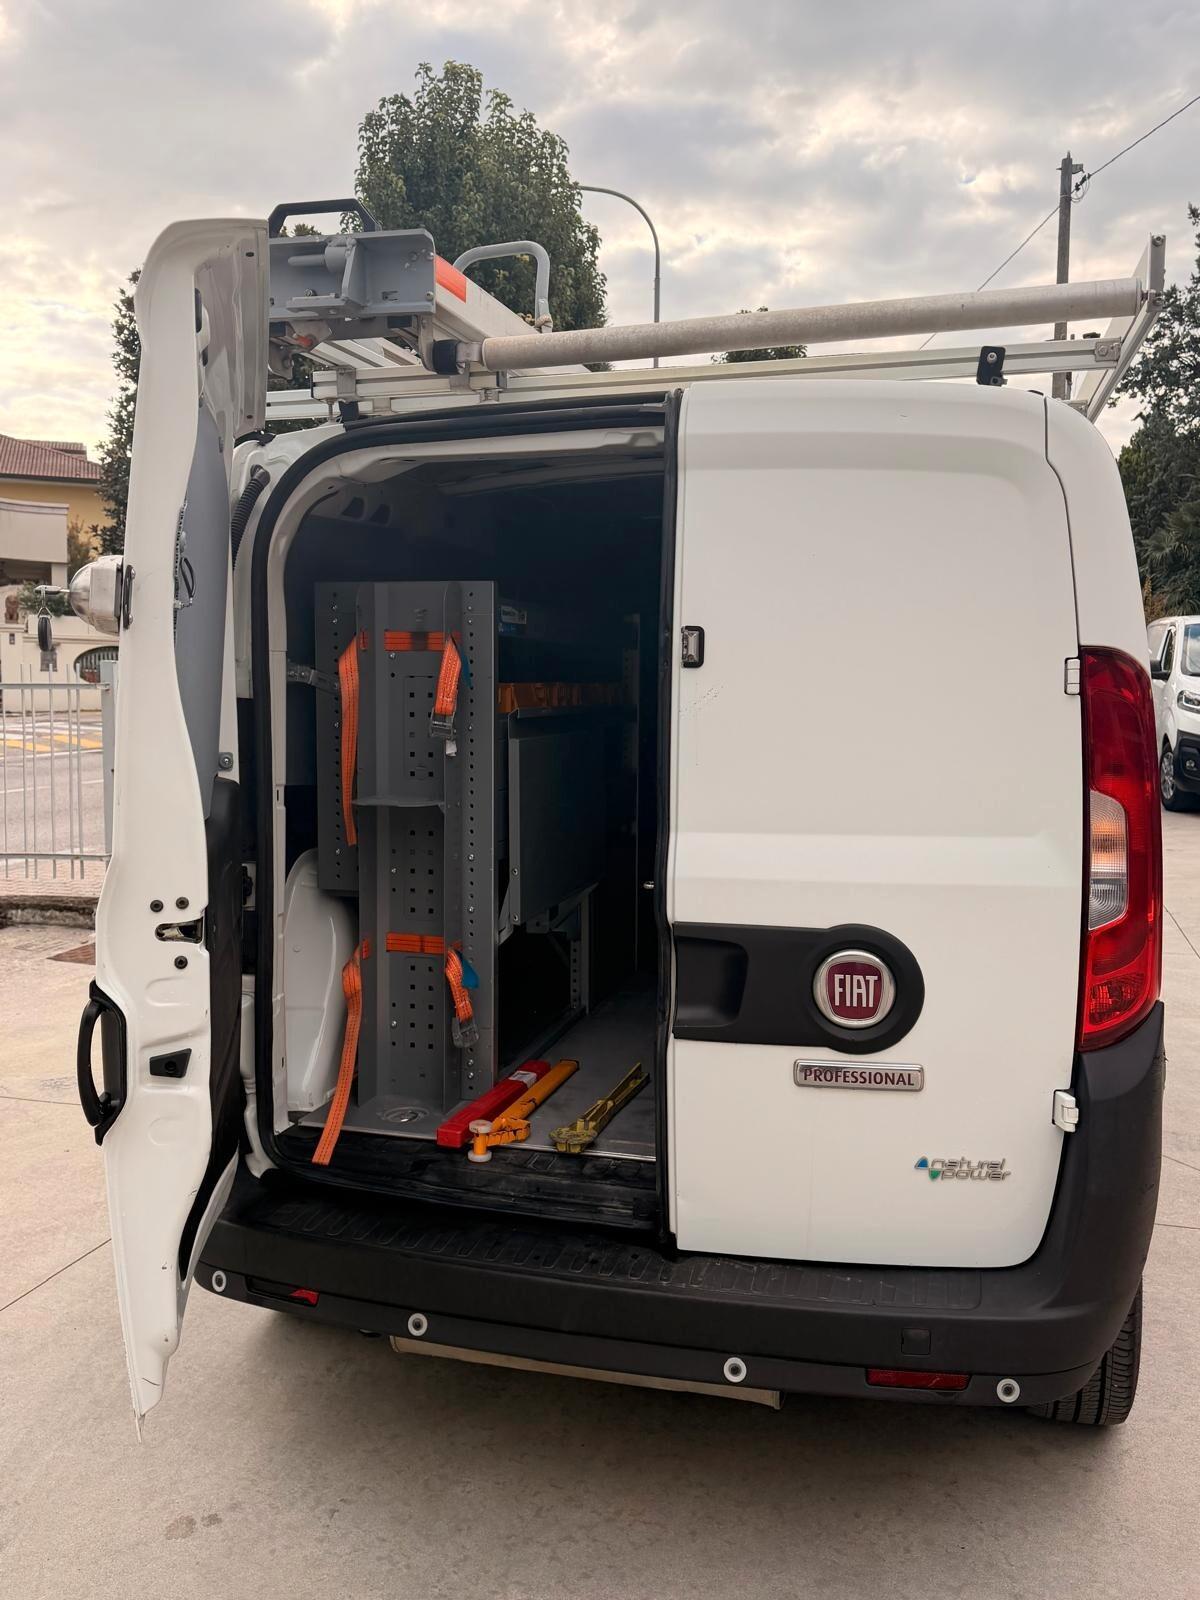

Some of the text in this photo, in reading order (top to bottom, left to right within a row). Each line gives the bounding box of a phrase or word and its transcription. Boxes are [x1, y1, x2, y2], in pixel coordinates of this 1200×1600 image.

[834, 974, 878, 1008] FIAT
[803, 1068, 914, 1086] PROFESSIONAL
[931, 1156, 1006, 1170] natural
[941, 1169, 1012, 1180] power
